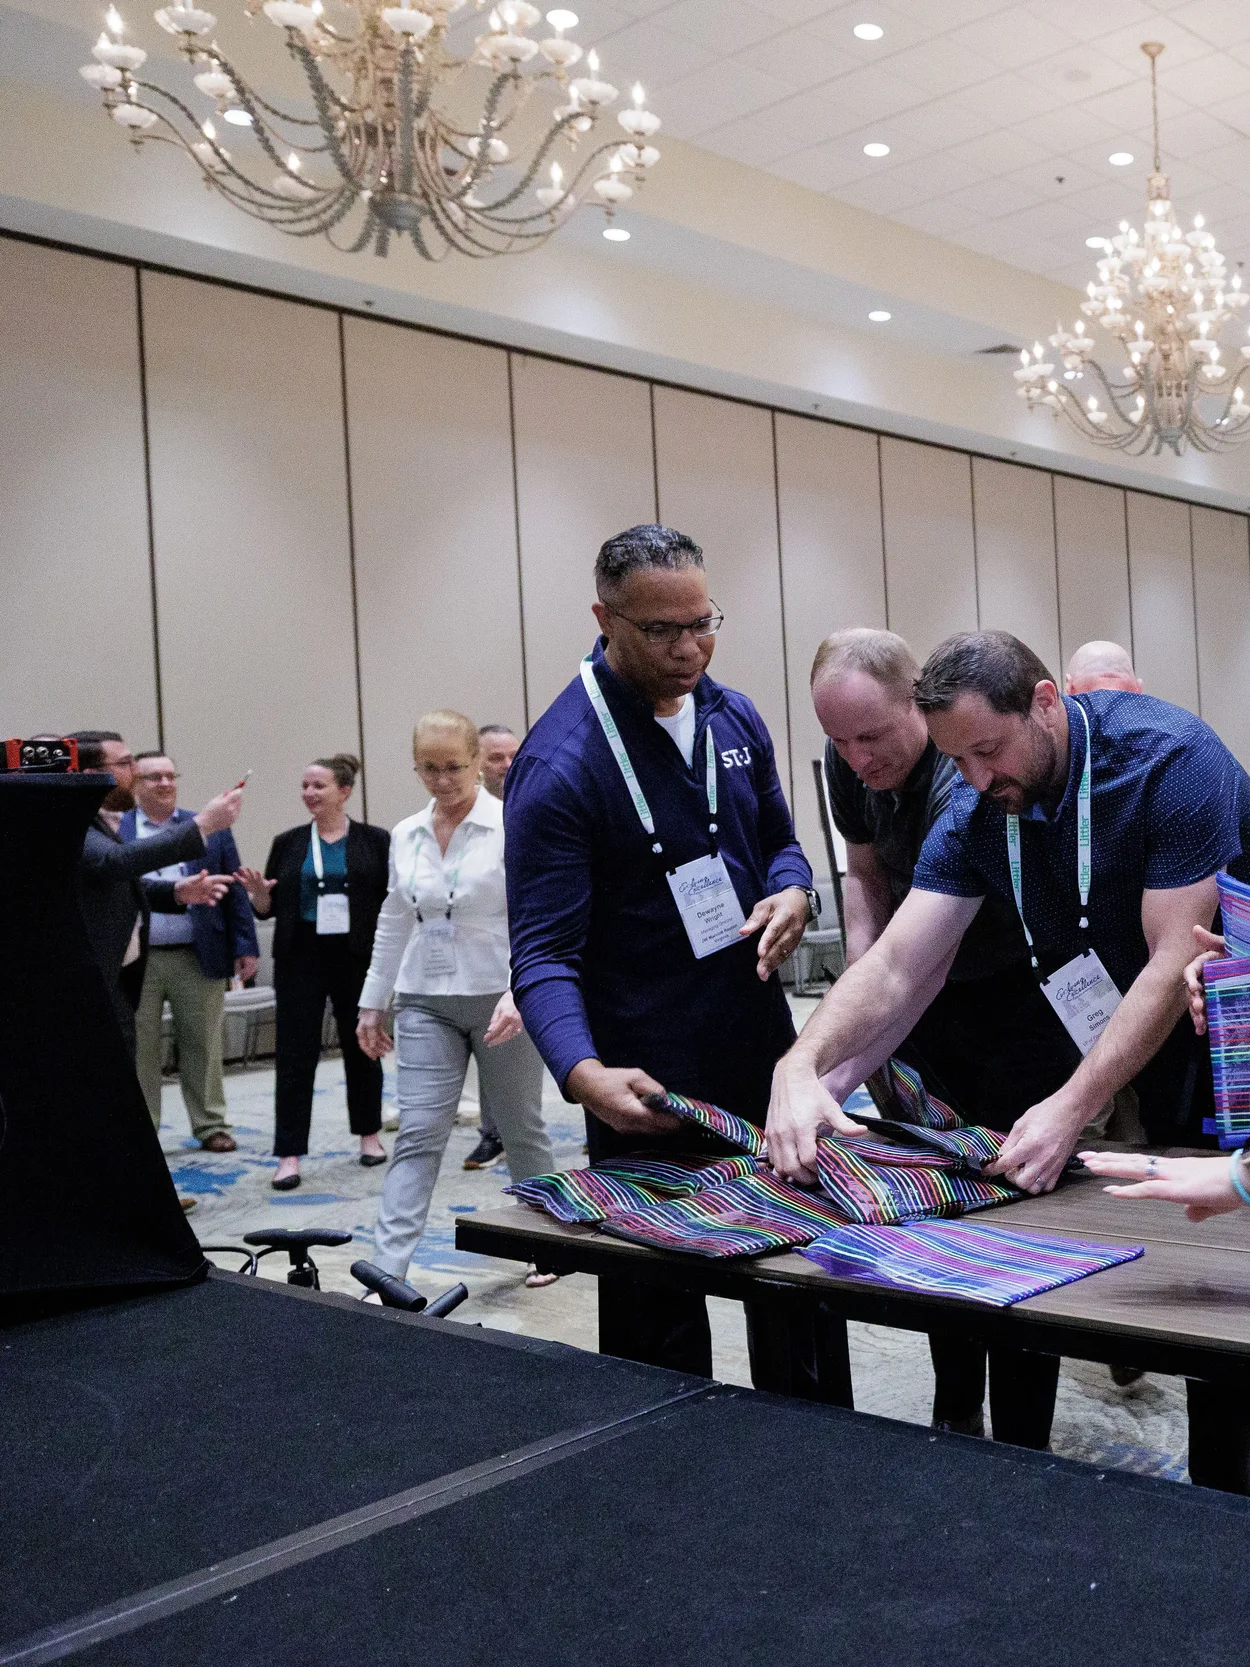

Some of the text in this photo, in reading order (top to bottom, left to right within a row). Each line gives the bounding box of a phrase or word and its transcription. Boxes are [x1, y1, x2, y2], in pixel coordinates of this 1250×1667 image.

[601, 711, 618, 739] Littler
[618, 750, 634, 779] Littler
[634, 791, 651, 821] Littler
[1080, 815, 1090, 847] Littler
[1011, 861, 1020, 893] Littler
[1080, 862, 1090, 894] Littler
[697, 903, 725, 918] Dewayne
[704, 912, 723, 924] Wright
[1087, 1009, 1104, 1022] Greg
[1089, 1015, 1111, 1031] Simons
